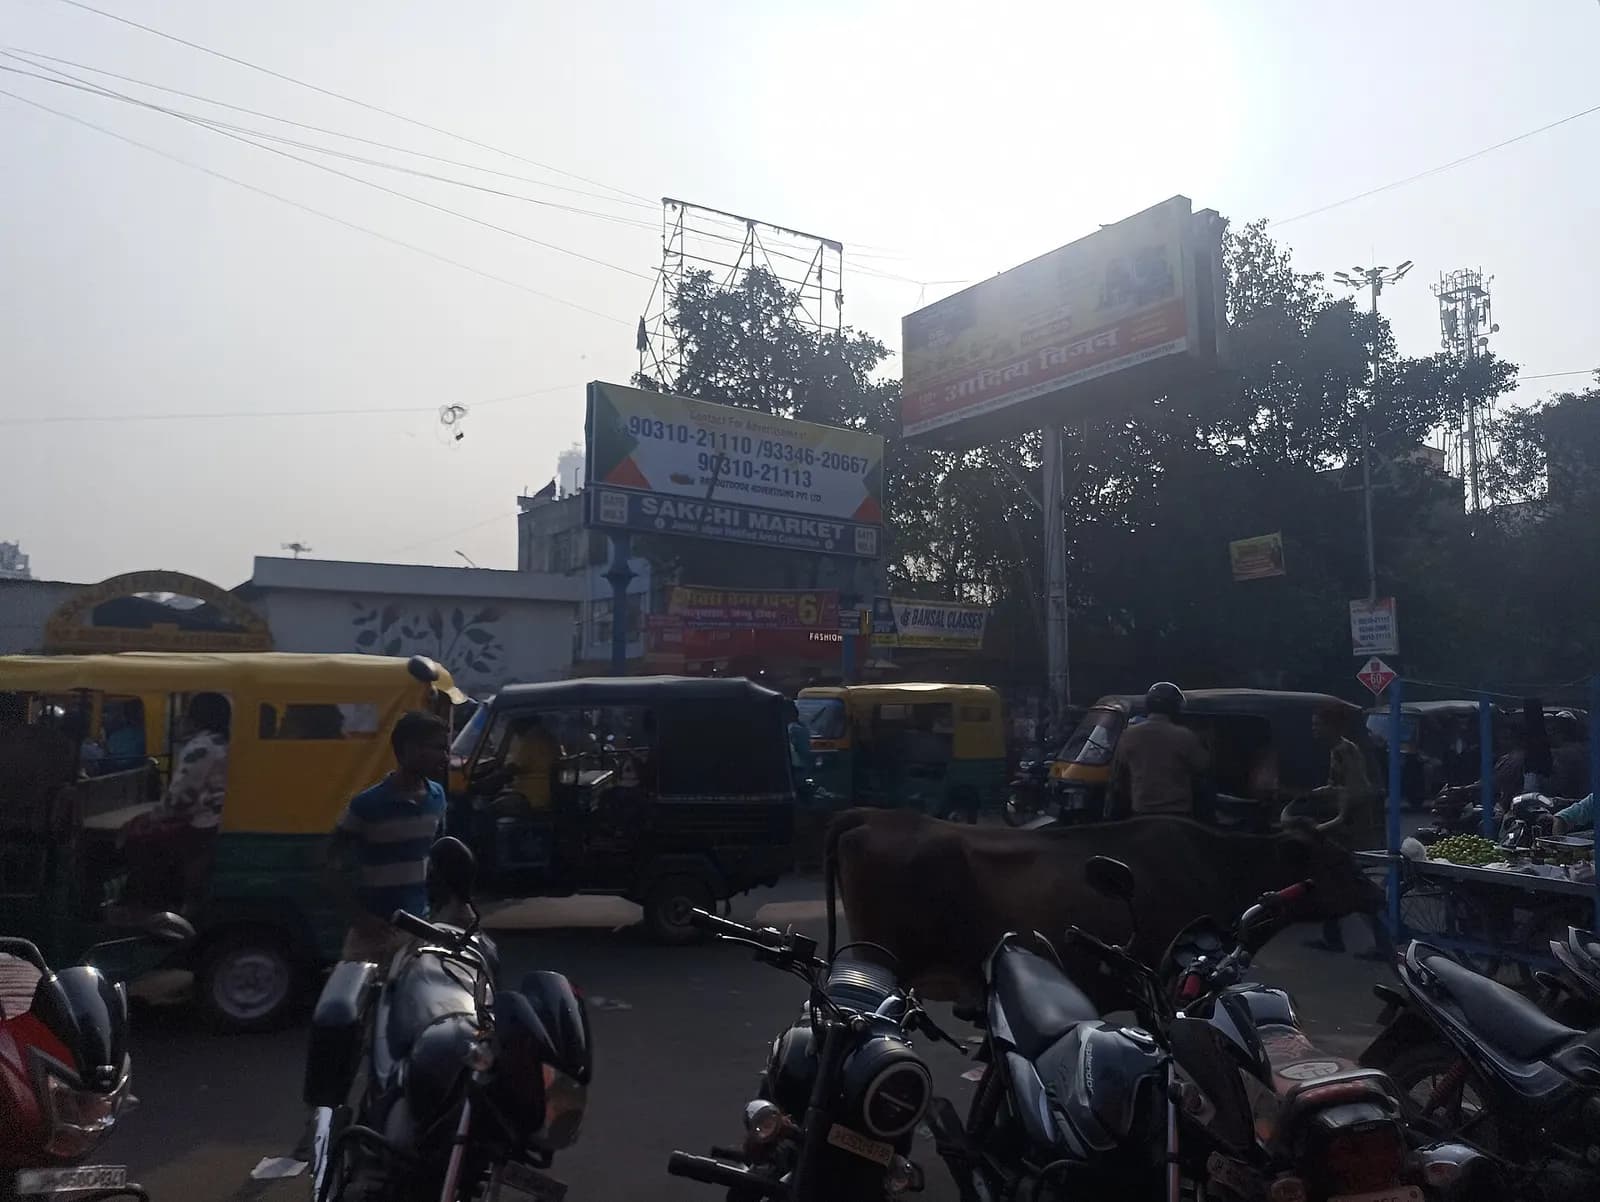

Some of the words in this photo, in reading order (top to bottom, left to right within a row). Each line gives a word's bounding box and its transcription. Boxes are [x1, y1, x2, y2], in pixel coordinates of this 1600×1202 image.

[629, 415, 751, 455] 90310-21110
[698, 452, 812, 488] 90310-21113
[748, 512, 845, 539] MARKET
[911, 607, 945, 627] BANSAL
[947, 611, 984, 630] CLASSES
[809, 631, 843, 642] FASHION
